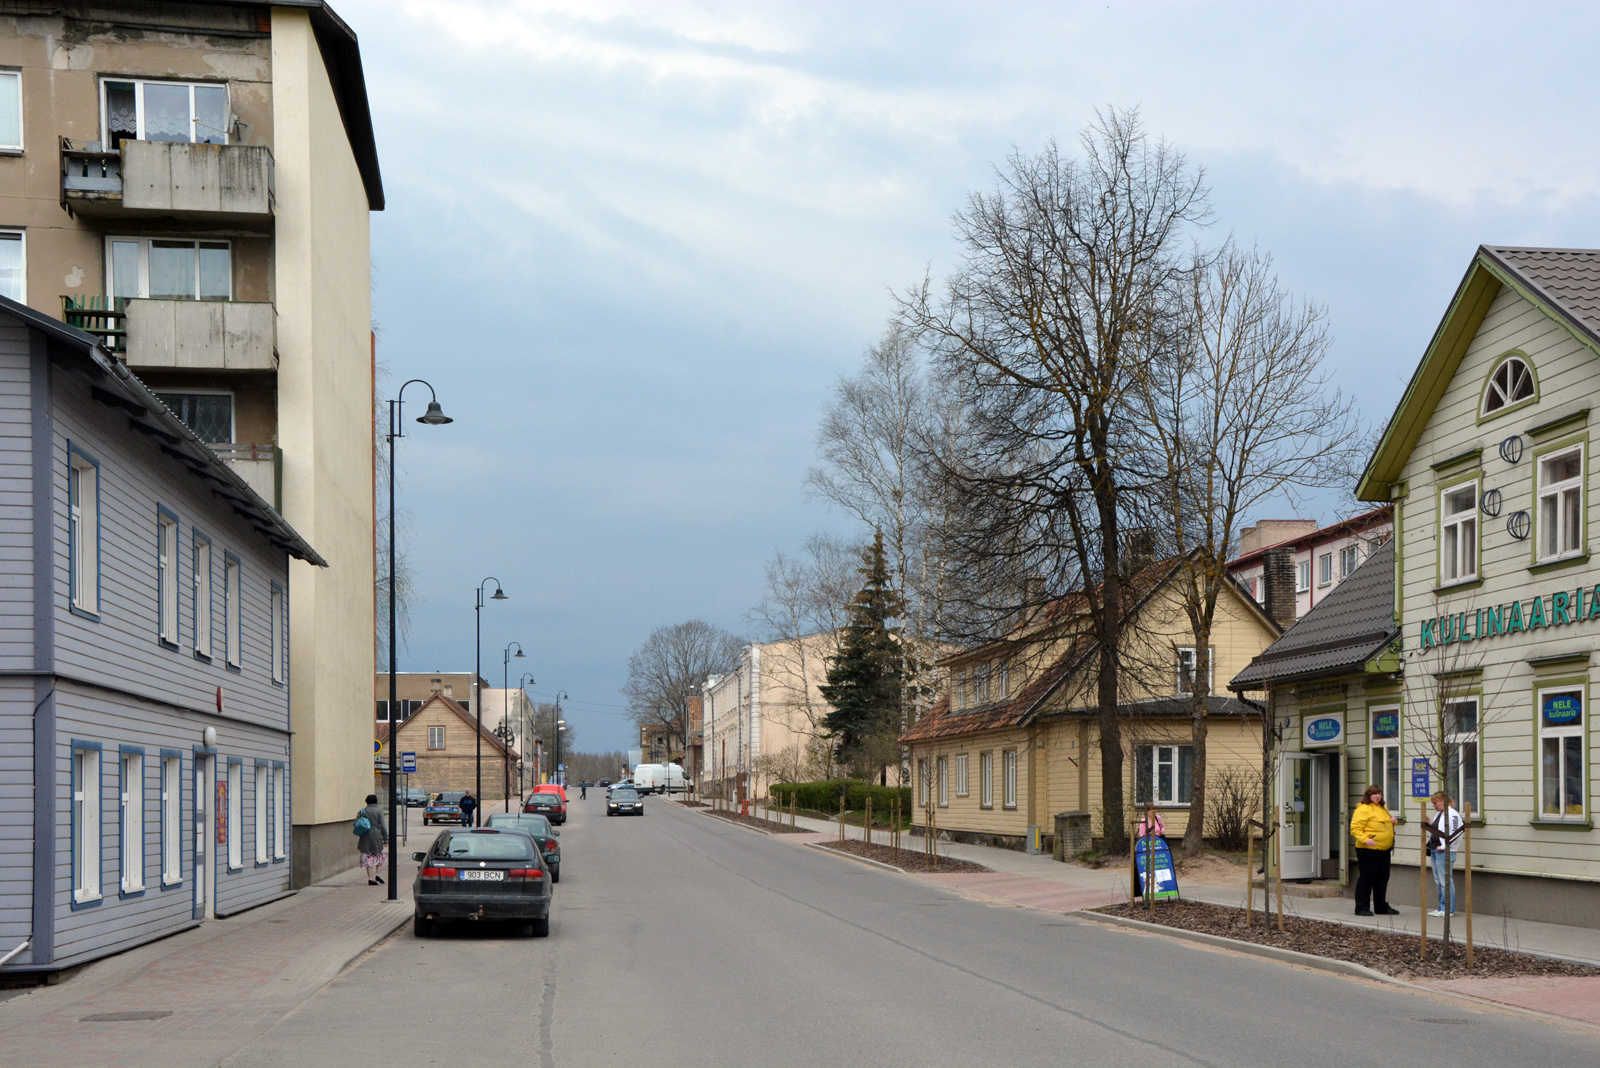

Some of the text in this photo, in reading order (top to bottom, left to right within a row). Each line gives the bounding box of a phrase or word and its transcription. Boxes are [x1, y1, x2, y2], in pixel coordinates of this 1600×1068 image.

[1421, 584, 1600, 648] KULINAARIA
[1553, 700, 1571, 709] NELE
[1549, 709, 1577, 718] kulinaaria
[1379, 716, 1392, 724] NELE
[1318, 721, 1333, 730] NELE
[467, 871, 501, 879] 903 BCN
